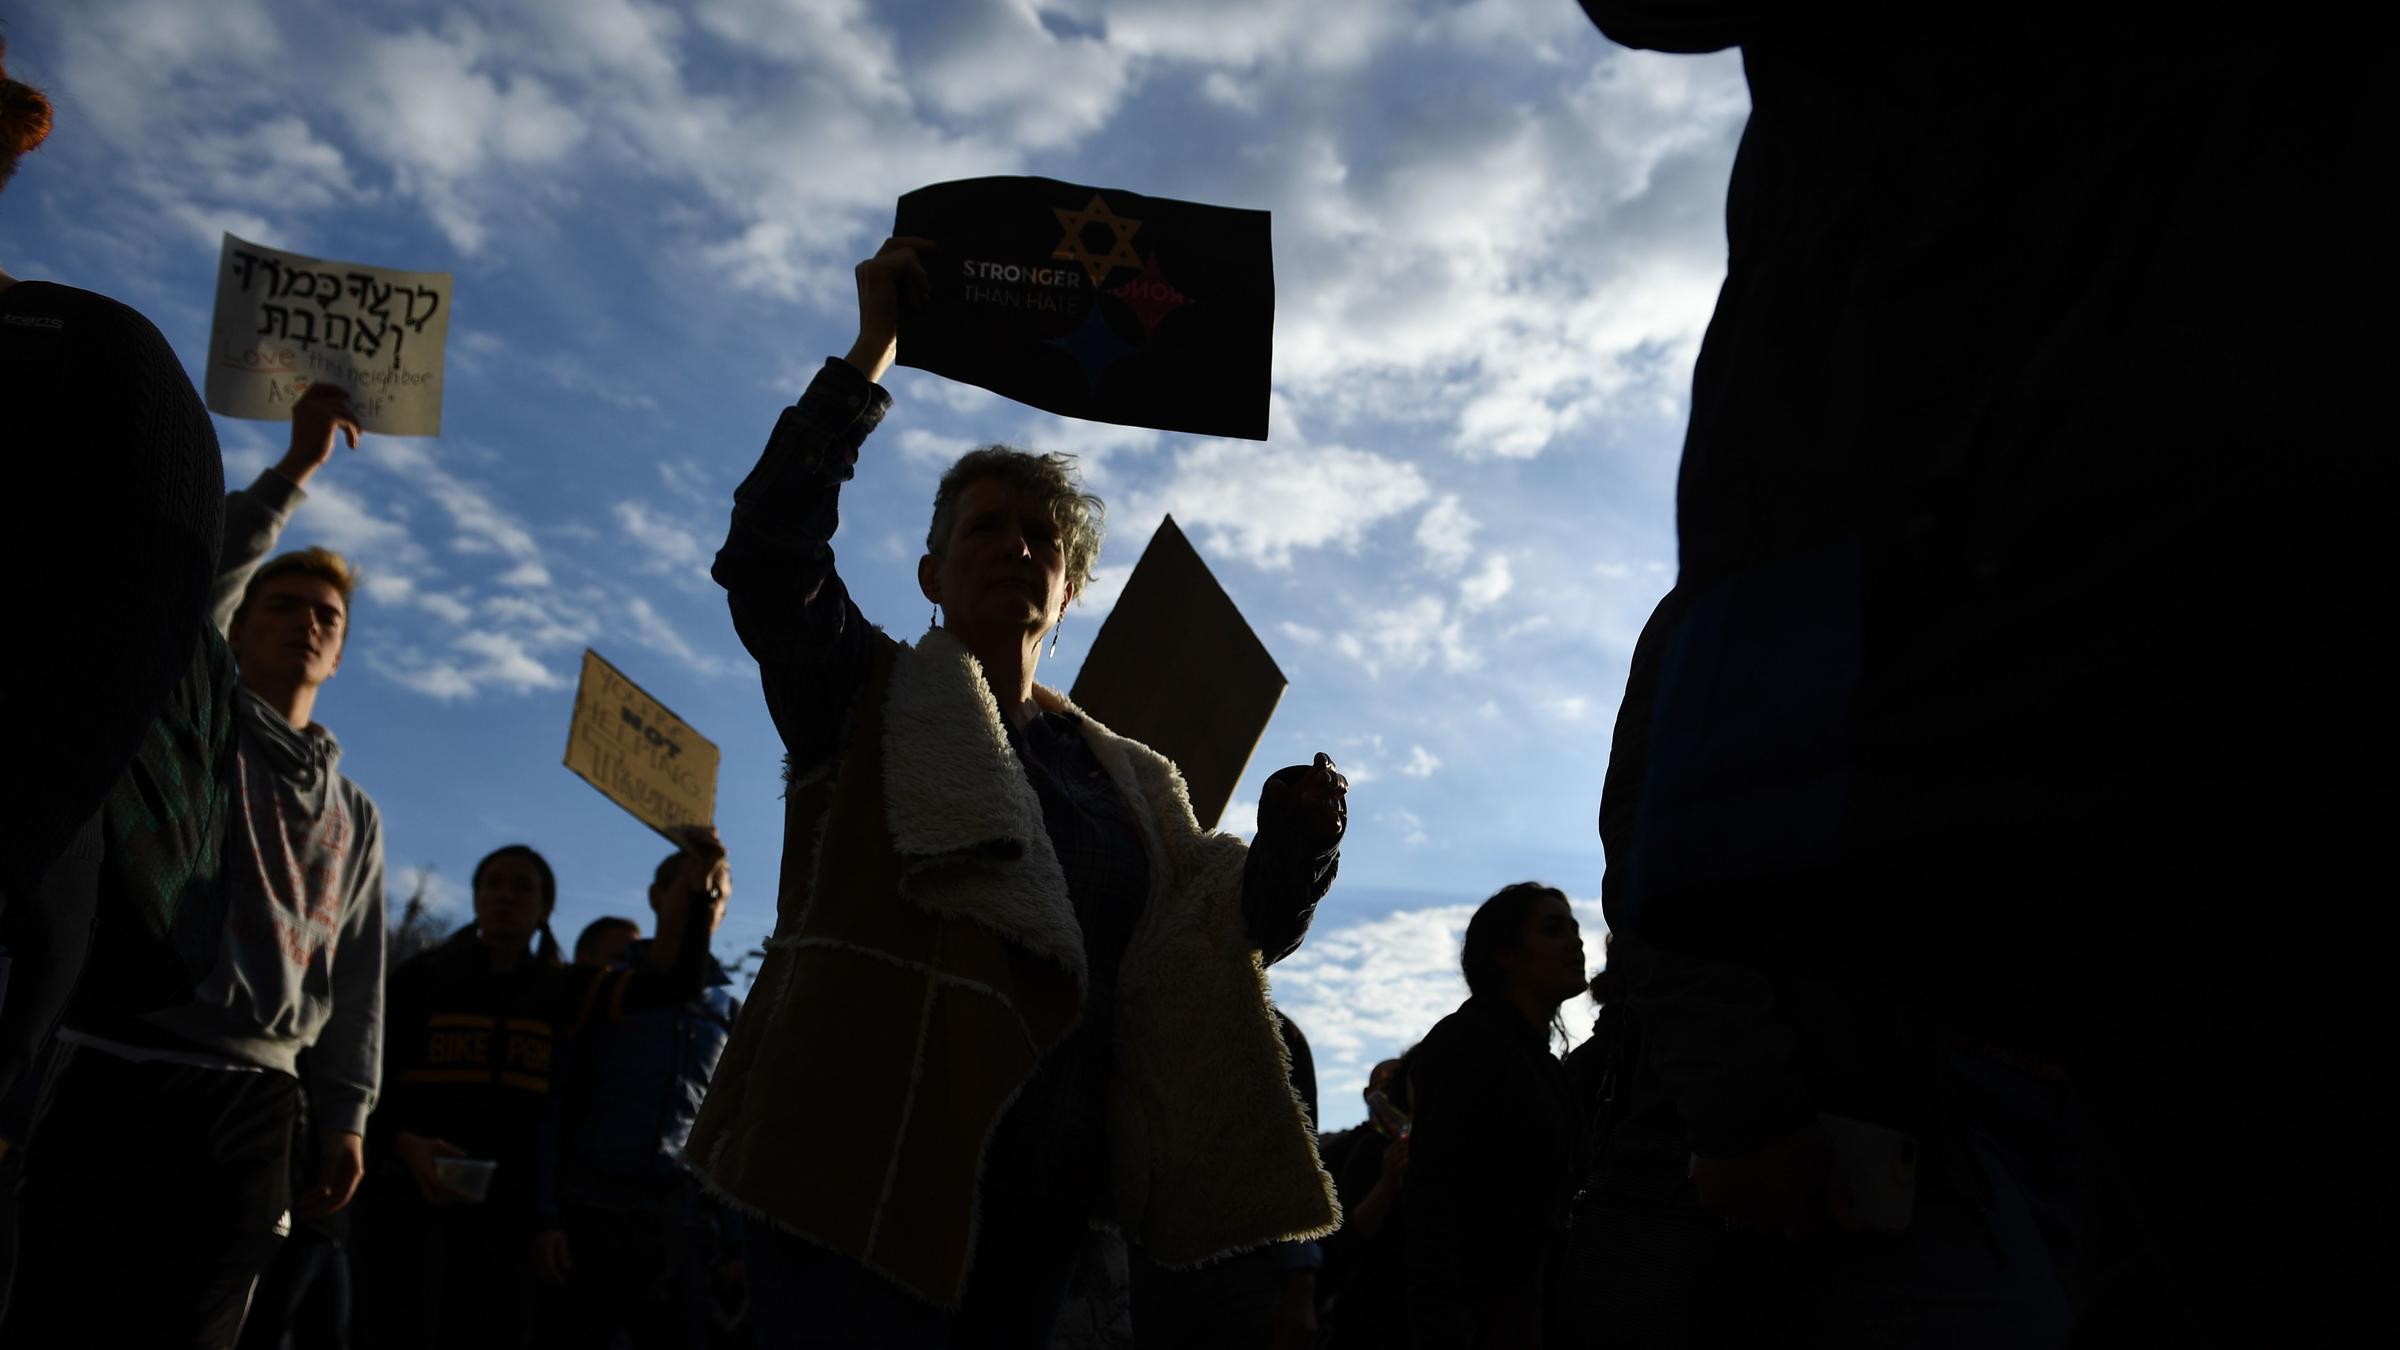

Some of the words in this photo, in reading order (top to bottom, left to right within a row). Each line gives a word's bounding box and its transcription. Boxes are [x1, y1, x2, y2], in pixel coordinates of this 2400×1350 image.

[961, 258, 1081, 290] STRONGER
[962, 283, 1021, 311] THAN
[1023, 289, 1081, 315] HATE
[223, 340, 296, 366] Love
[619, 704, 683, 760] NOT
[430, 1031, 489, 1064] BIKE
